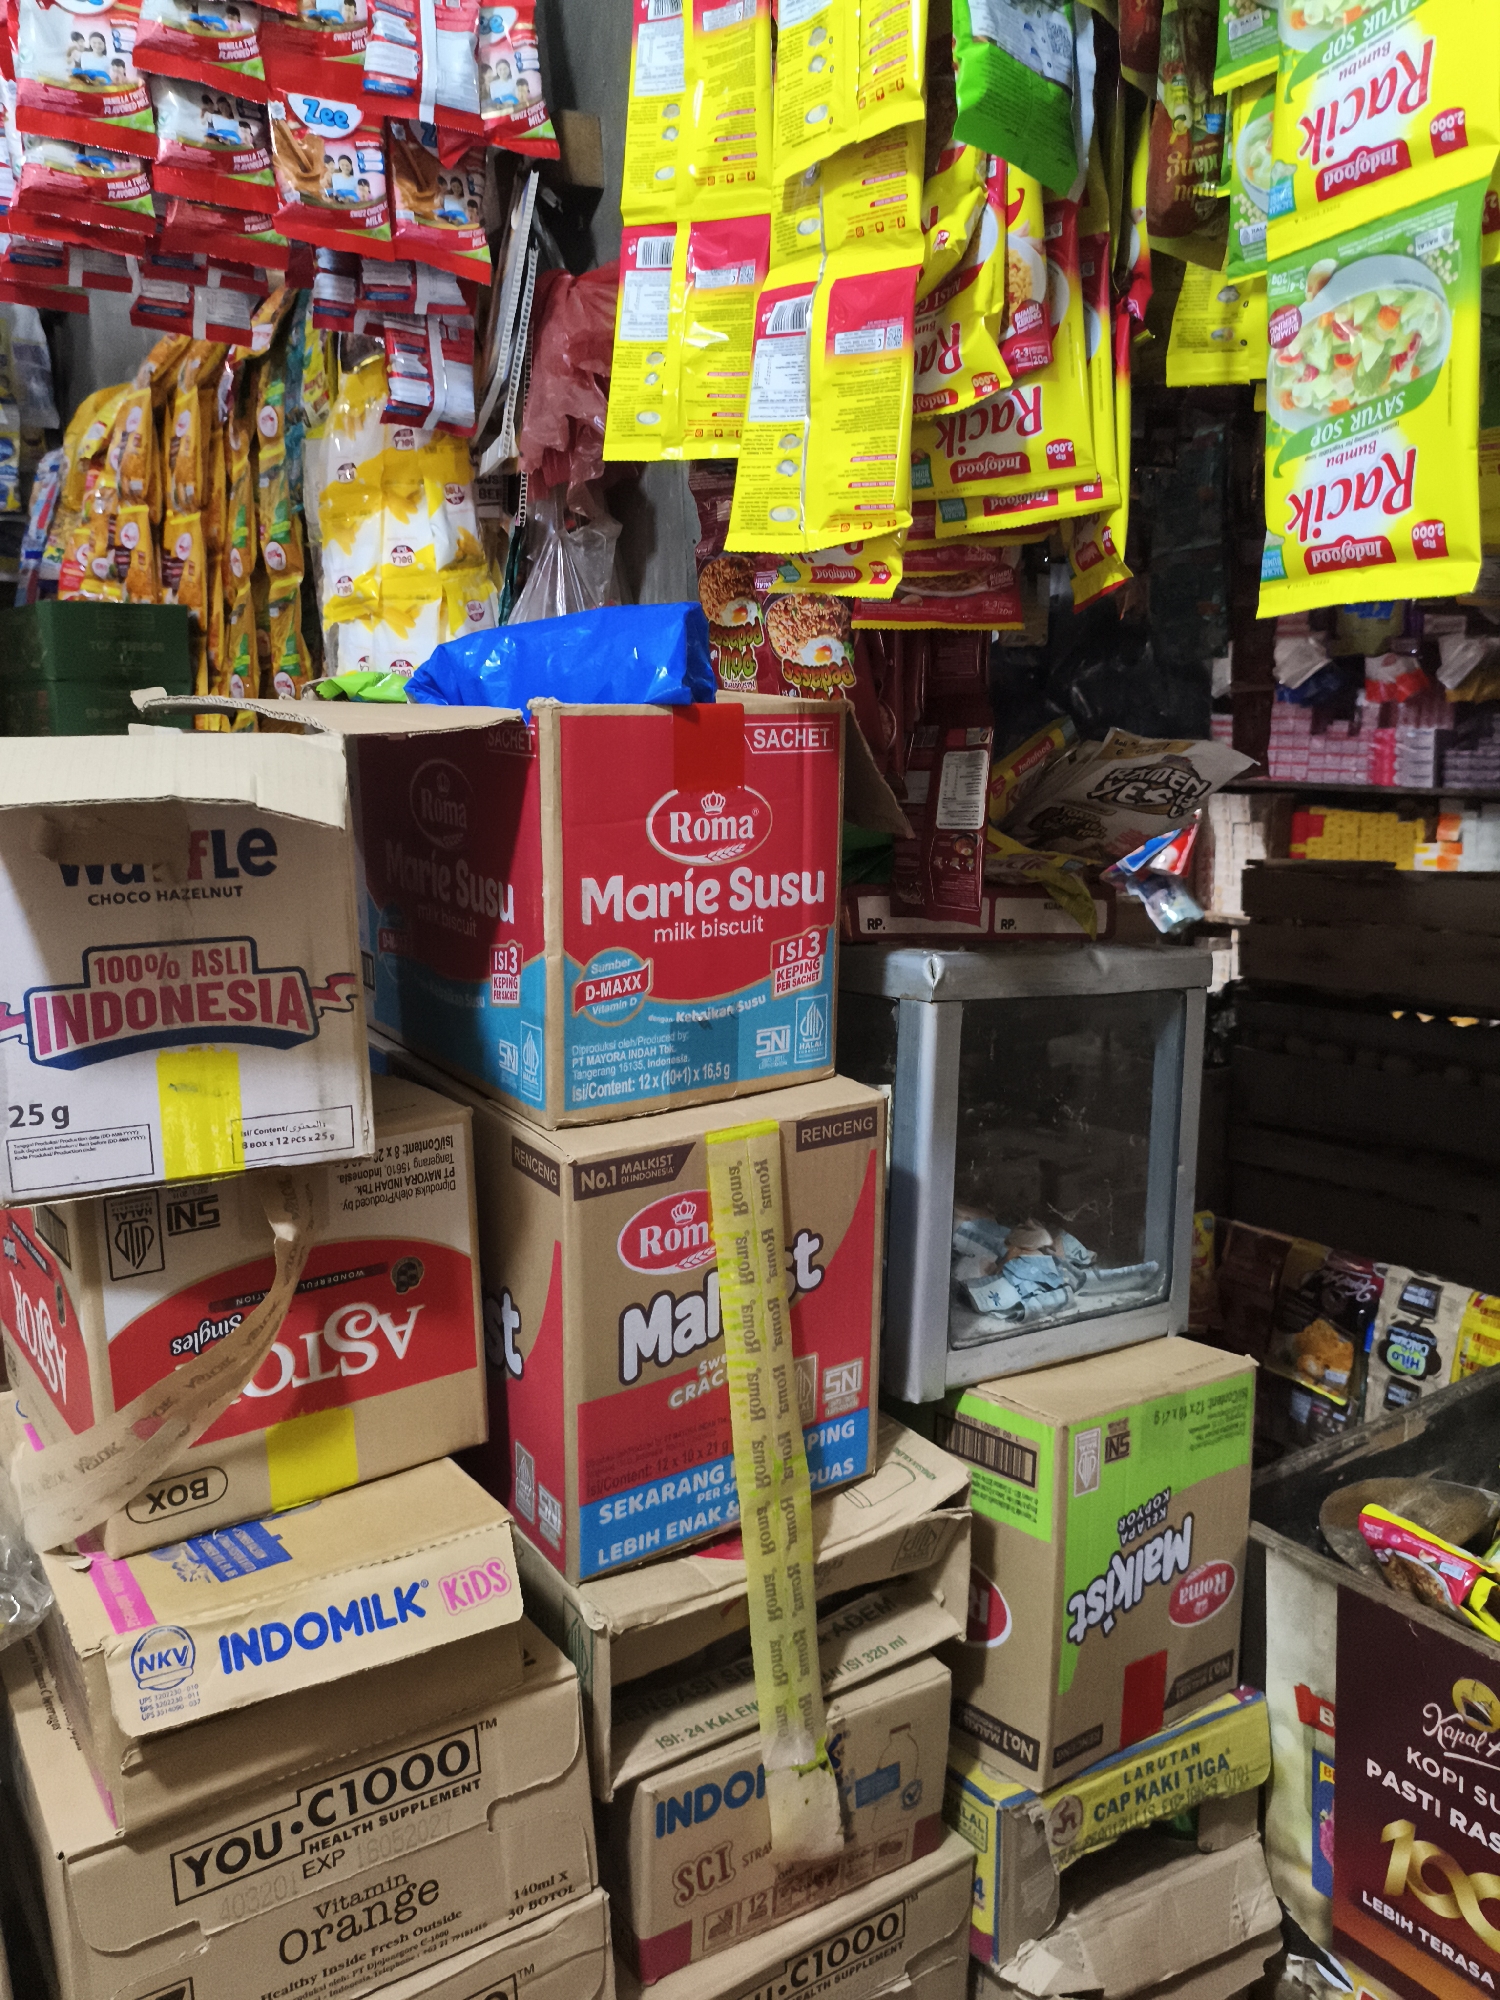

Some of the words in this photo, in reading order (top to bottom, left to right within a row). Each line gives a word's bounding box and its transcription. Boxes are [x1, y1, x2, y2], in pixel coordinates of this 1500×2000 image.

[1322, 26, 1357, 64] SOP
[1339, 42, 1391, 82] Bumbu
[303, 98, 350, 129] Zee
[1299, 39, 1434, 166] Racik
[1431, 111, 1465, 134] 2.000
[1324, 143, 1399, 191] Indofood
[365, 215, 383, 228] MILK
[935, 385, 1045, 459] Racik
[1350, 391, 1406, 431] SAYUR
[1046, 441, 1074, 455] 2.000
[1310, 419, 1345, 448] SOP
[957, 453, 1021, 478] Indofood
[1326, 440, 1378, 468] Bumbu
[1286, 448, 1416, 543] Racik
[1413, 523, 1445, 540] 2.000
[390, 552, 414, 564] BOLA
[1311, 541, 1383, 568] Indofood
[488, 729, 534, 751] SACHET
[753, 728, 830, 749] SACHET
[421, 788, 468, 829] Roma
[669, 811, 755, 844] Roma
[88, 890, 151, 907] CHOCO
[157, 885, 244, 901] HAZELNUT
[455, 859, 515, 924] Susu
[581, 867, 721, 925] Marie
[729, 866, 825, 911] Susu
[654, 921, 697, 944] milk
[701, 914, 765, 938] biscuit
[867, 918, 886, 930] RP.
[1001, 919, 1017, 930] RP.
[494, 951, 508, 970] ISI
[509, 946, 518, 973] 3
[779, 941, 802, 963] ISI
[807, 931, 821, 958] 3
[93, 952, 181, 985] 100%
[192, 945, 248, 979] ASLI
[591, 957, 632, 975] Sumber
[776, 958, 821, 982] KEPING
[493, 976, 518, 989] KEPING
[585, 974, 642, 1001] D-MAXX
[33, 976, 311, 1057] INDONESIA
[592, 1000, 628, 1015] Vitamin
[736, 995, 766, 1012] Susu
[756, 1026, 790, 1055] SNI
[586, 1051, 627, 1066] MAYORA
[627, 1047, 657, 1061] INDAH
[572, 1064, 616, 1082] Tangerang
[572, 1078, 636, 1103] Isi/Content:
[8, 1103, 45, 1128] 25
[51, 1104, 70, 1130] g
[254, 1125, 288, 1136] Content/
[801, 1115, 874, 1144] RENCENG
[249, 1139, 268, 1148] BOX
[276, 1136, 288, 1145] 12
[291, 1135, 307, 1144] PCS
[314, 1131, 328, 1141] 25
[402, 1134, 454, 1155] Isi/Content:
[336, 1167, 383, 1184] Indonesia.
[413, 1153, 454, 1168] Tangerang
[443, 1167, 456, 1178] PT
[514, 1145, 558, 1186] RENCENG
[580, 1165, 617, 1193] No.1
[620, 1153, 673, 1174] MALKIST
[374, 1177, 404, 1193] INDAH
[405, 1169, 442, 1185] MAYORA
[415, 1179, 456, 1197] Diproduksi
[355, 1187, 413, 1210] oleh/Produced
[112, 1207, 152, 1221] HALAL
[166, 1195, 220, 1236] SNI
[639, 1220, 709, 1259] Rom
[300, 1269, 366, 1290] WONDERFUL
[171, 1314, 243, 1355] Singles
[824, 1360, 862, 1400] SNI
[145, 1476, 209, 1515] BOX
[599, 1464, 724, 1525] SEKARANG
[1118, 1488, 1172, 1532] KOPYOR
[598, 1528, 660, 1566] LEBIH
[666, 1506, 722, 1540] ENAK
[1120, 1506, 1168, 1545] KELAPA
[1068, 1513, 1193, 1644] Malkist
[1178, 1571, 1228, 1605] Roma
[217, 1581, 427, 1675] INDOMILK
[832, 1596, 897, 1638] ADEM
[137, 1645, 189, 1675] NKV
[842, 1652, 864, 1674] ISI
[862, 1644, 889, 1664] 320
[655, 1733, 684, 1750] ISI:
[687, 1724, 705, 1740] 24
[1421, 1702, 1488, 1755] Kapal
[1002, 1731, 1035, 1764] No.1
[1122, 1741, 1200, 1785] LARUTAN
[1406, 1746, 1465, 1795] KOPI
[1093, 1792, 1131, 1822] CAP
[1135, 1770, 1181, 1801] KAKI
[1187, 1752, 1230, 1783] TIGA
[1365, 1758, 1441, 1818] PASTI
[309, 1820, 374, 1854] HEALTH
[379, 1779, 481, 1827] SUPPLEMENT
[302, 1848, 347, 1879] EXP
[313, 1871, 409, 1920] Vitamin
[508, 1906, 524, 1920] 30
[528, 1884, 576, 1911] BOTOL
[514, 1875, 555, 1899] 140ml
[278, 1877, 440, 1966] Orange
[1361, 1890, 1413, 1934] LEBIH
[261, 1974, 318, 2000] Healthy
[322, 1952, 367, 1978] Inside
[371, 1935, 409, 1957] Fresh
[413, 1910, 463, 1938] Outside
[834, 1940, 904, 1984] SUPPLEMENT
